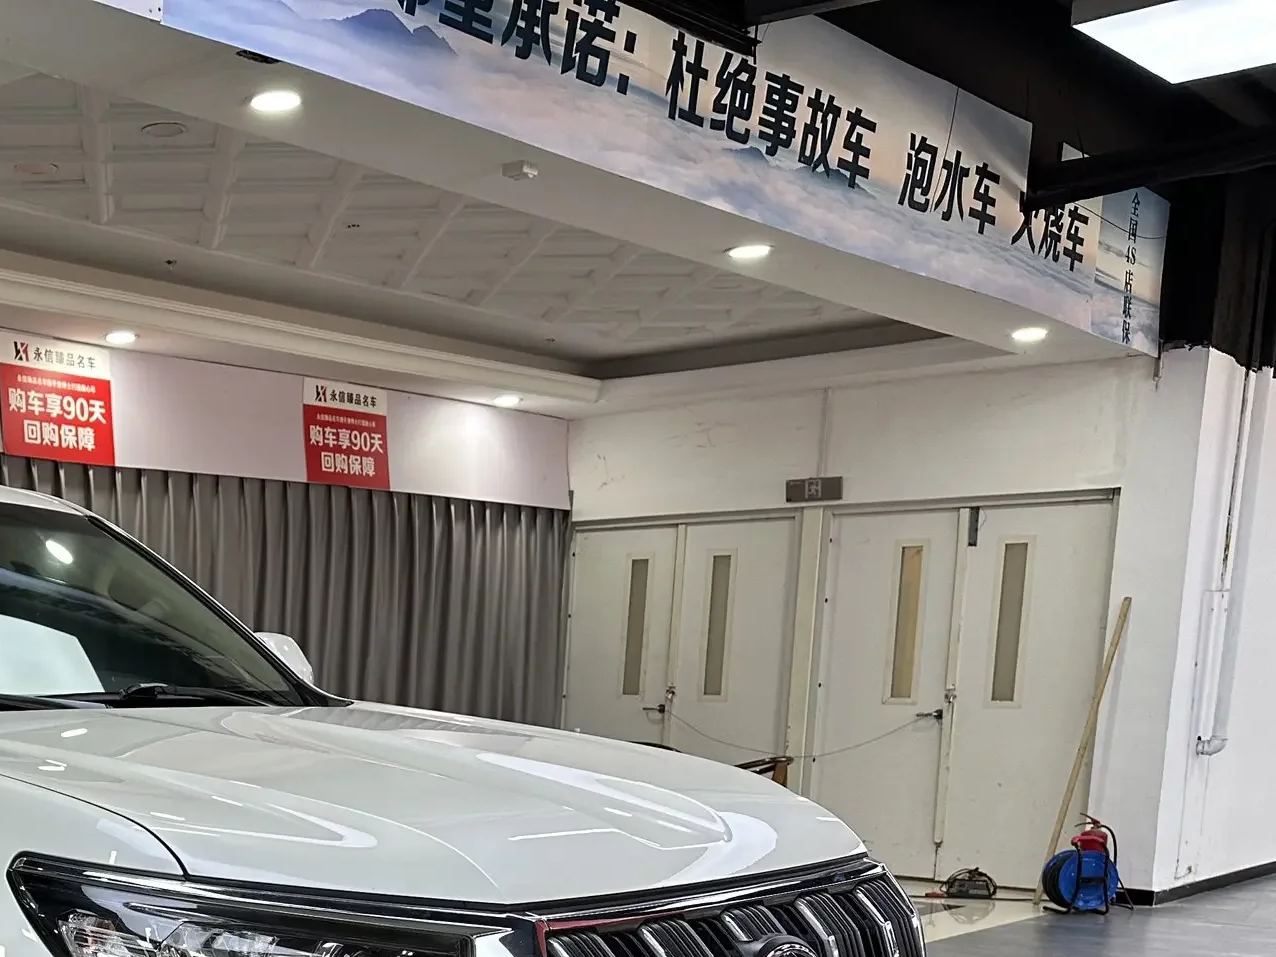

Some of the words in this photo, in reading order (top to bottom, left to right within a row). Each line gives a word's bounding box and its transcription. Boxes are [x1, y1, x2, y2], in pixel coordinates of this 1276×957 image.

[898, 132, 1000, 235] 泡水车
[8, 387, 107, 424] 购车享90天
[24, 419, 95, 451] 回购保障
[309, 424, 383, 454] 购车享90天
[321, 451, 375, 477] 回购保障
